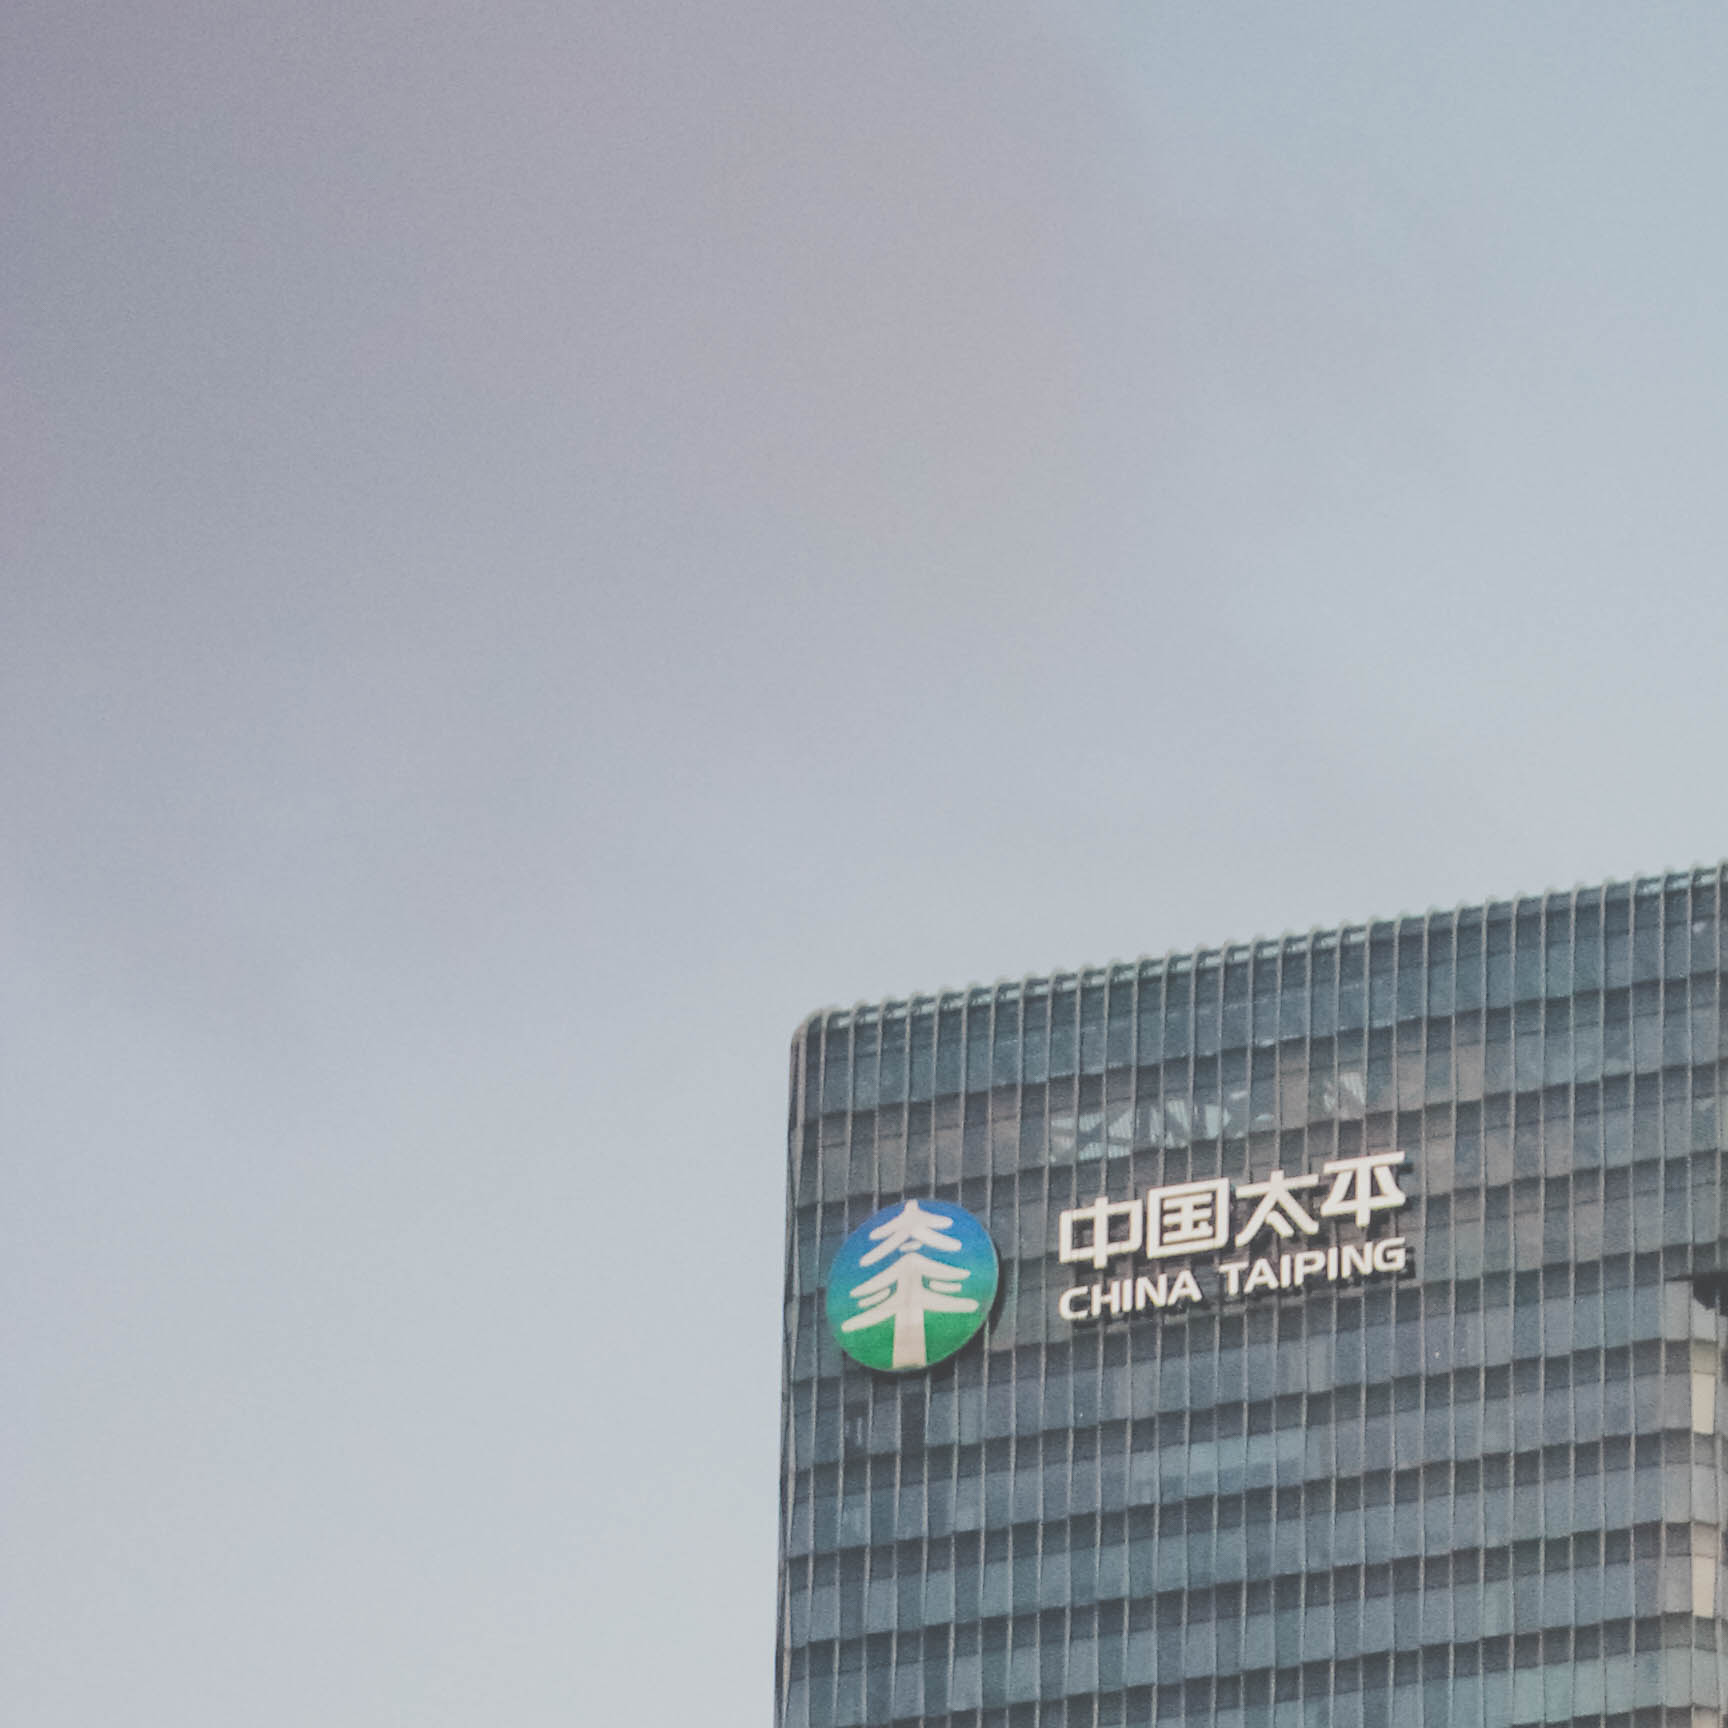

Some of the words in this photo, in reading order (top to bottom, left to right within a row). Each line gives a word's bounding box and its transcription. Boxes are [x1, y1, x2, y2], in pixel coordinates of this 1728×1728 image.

[1058, 1151, 1406, 1269] 中国太平
[1058, 1272, 1203, 1322] CHINA
[1218, 1236, 1407, 1297] TAIPING
